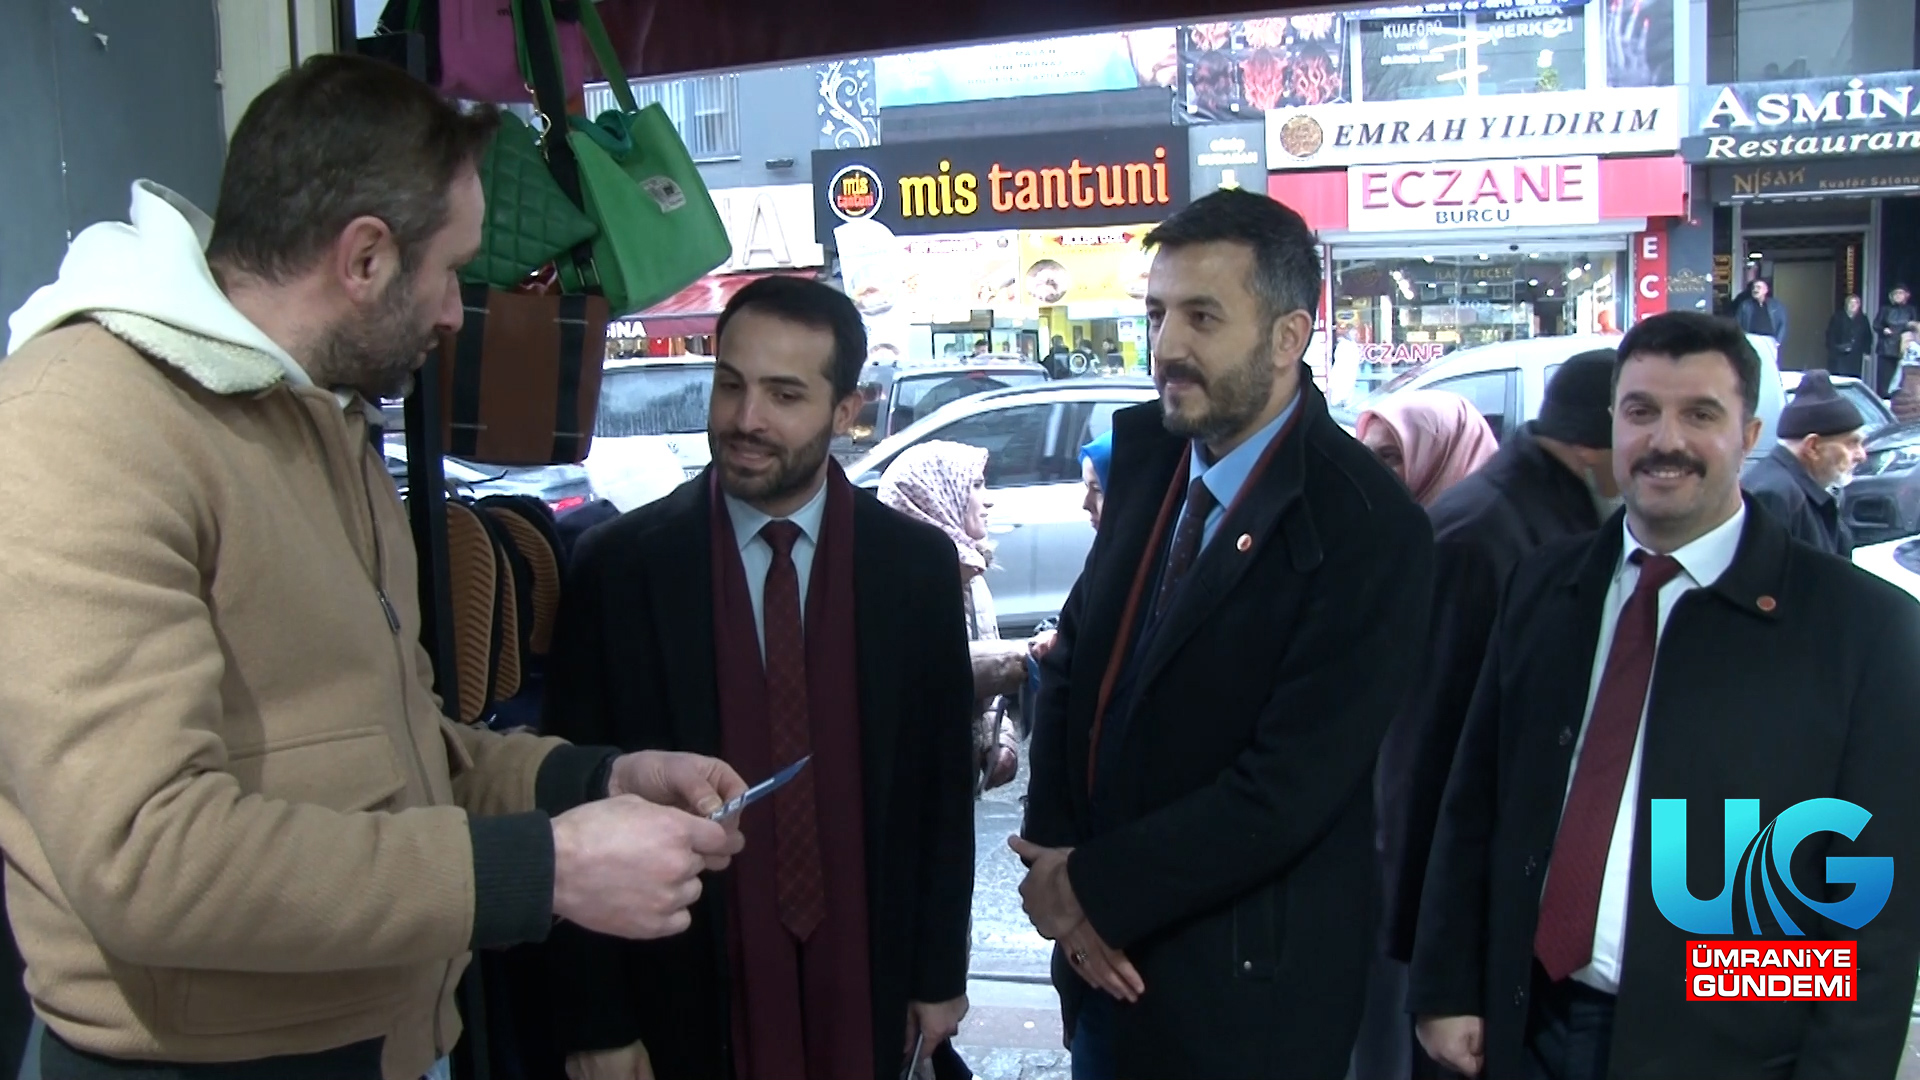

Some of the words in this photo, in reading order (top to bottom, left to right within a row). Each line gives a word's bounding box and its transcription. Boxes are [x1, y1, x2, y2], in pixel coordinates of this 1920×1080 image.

[1333, 120, 1470, 146] EMRAH
[1480, 108, 1660, 140] YILDIRIM
[843, 172, 868, 195] mis
[899, 160, 979, 217] mis
[988, 147, 1169, 212] tantuni
[1362, 164, 1583, 208] ECZANE
[1435, 209, 1510, 224] BURCU
[1358, 343, 1444, 362] CZANE
